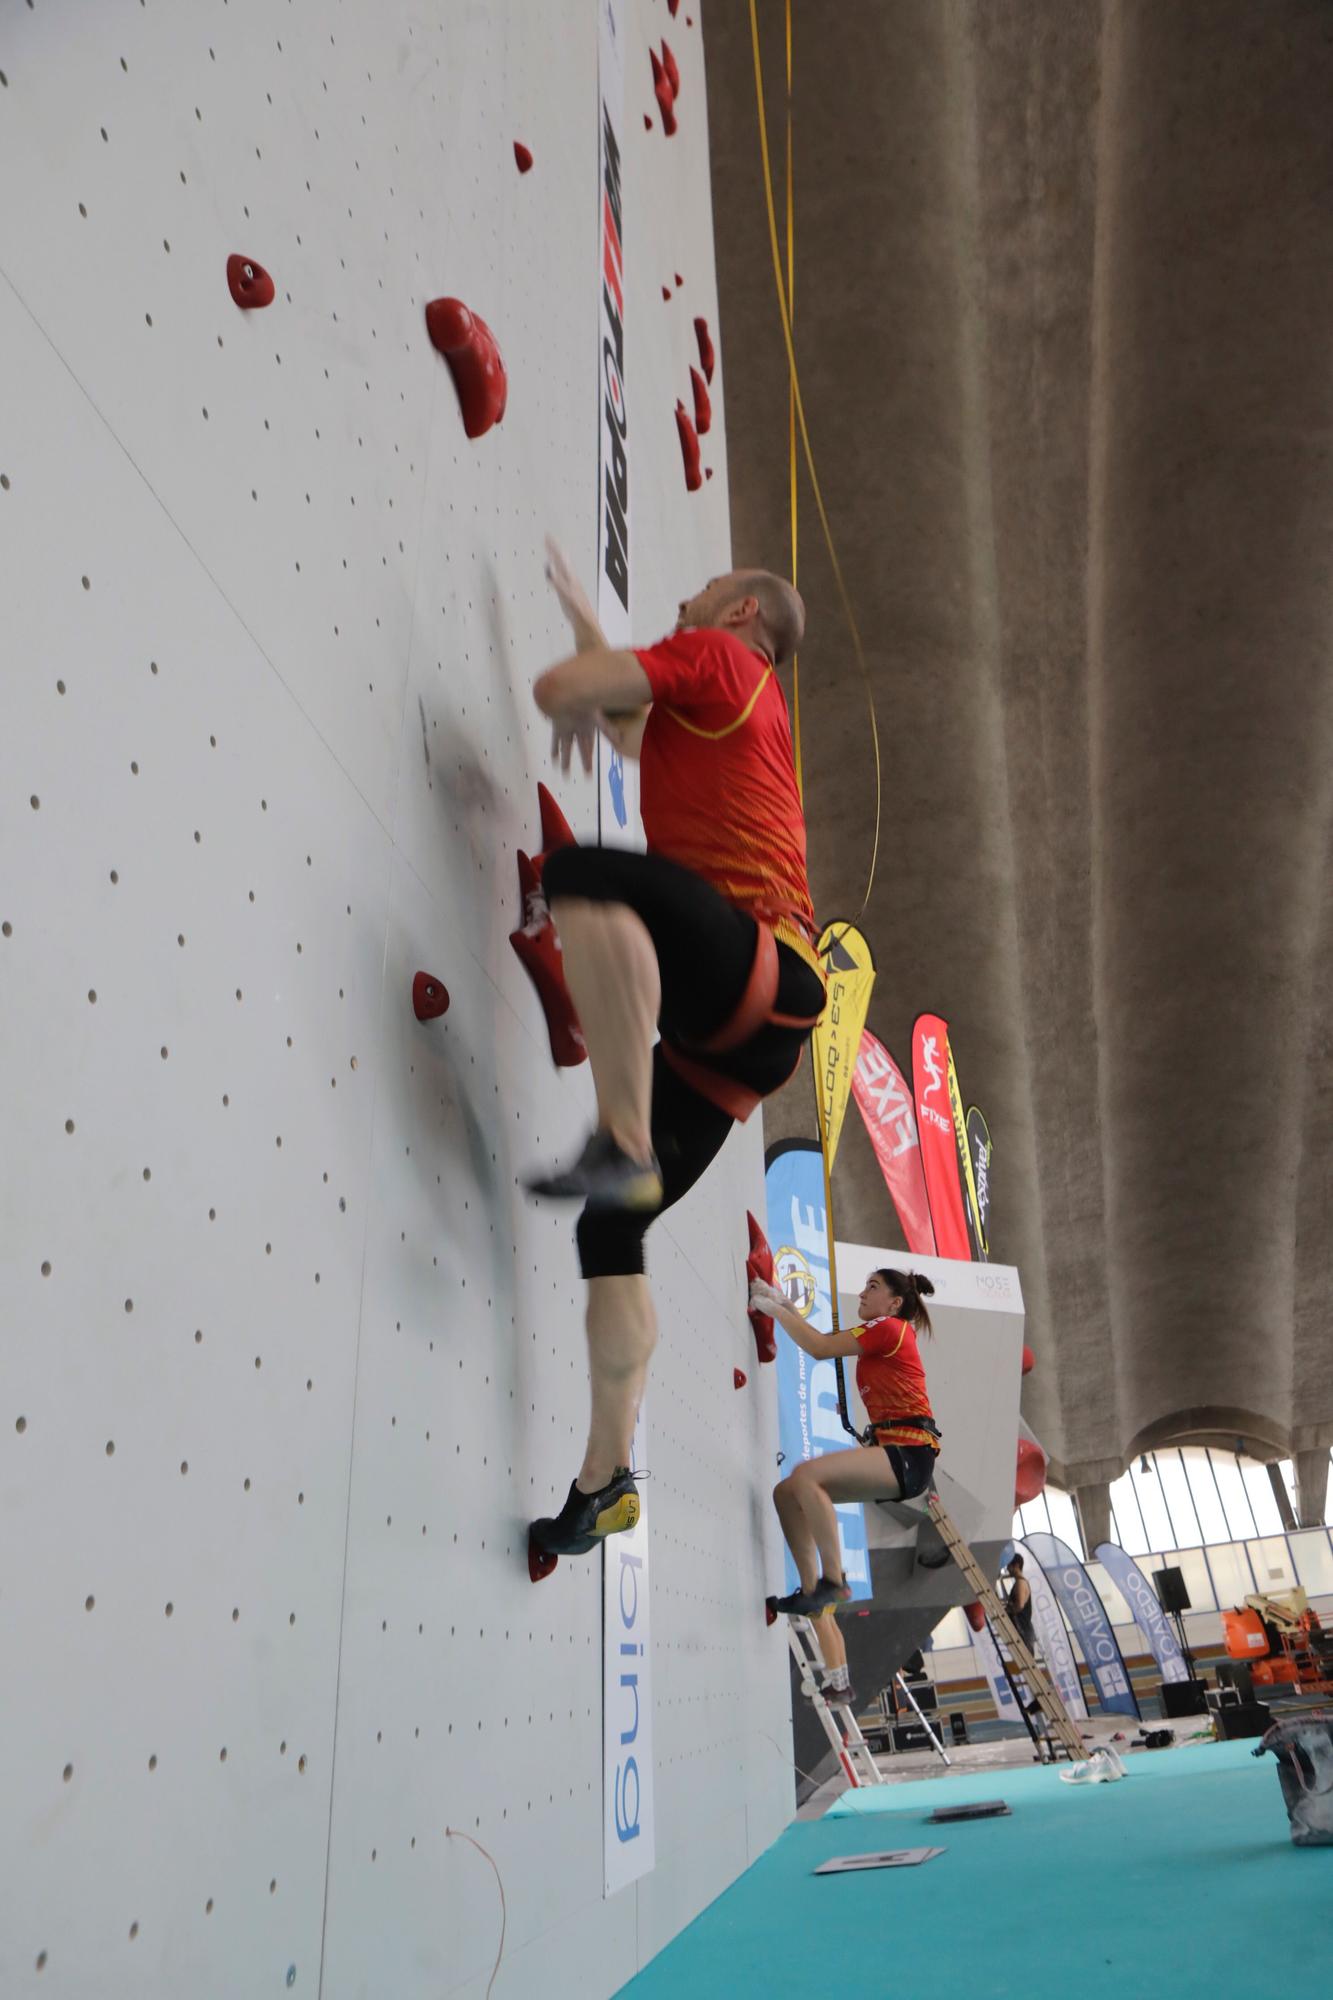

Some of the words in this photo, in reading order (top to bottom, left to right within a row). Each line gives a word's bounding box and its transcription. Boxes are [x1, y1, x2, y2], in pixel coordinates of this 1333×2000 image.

[602, 99, 629, 612] WALLTOPIA
[857, 1042, 918, 1157] FIXE
[920, 1103, 950, 1133] FIXE
[798, 1381, 807, 1400] de
[799, 1402, 811, 1461] deportes
[1064, 1568, 1115, 1662] OVIEDO
[1127, 1572, 1175, 1656] OVIEDO
